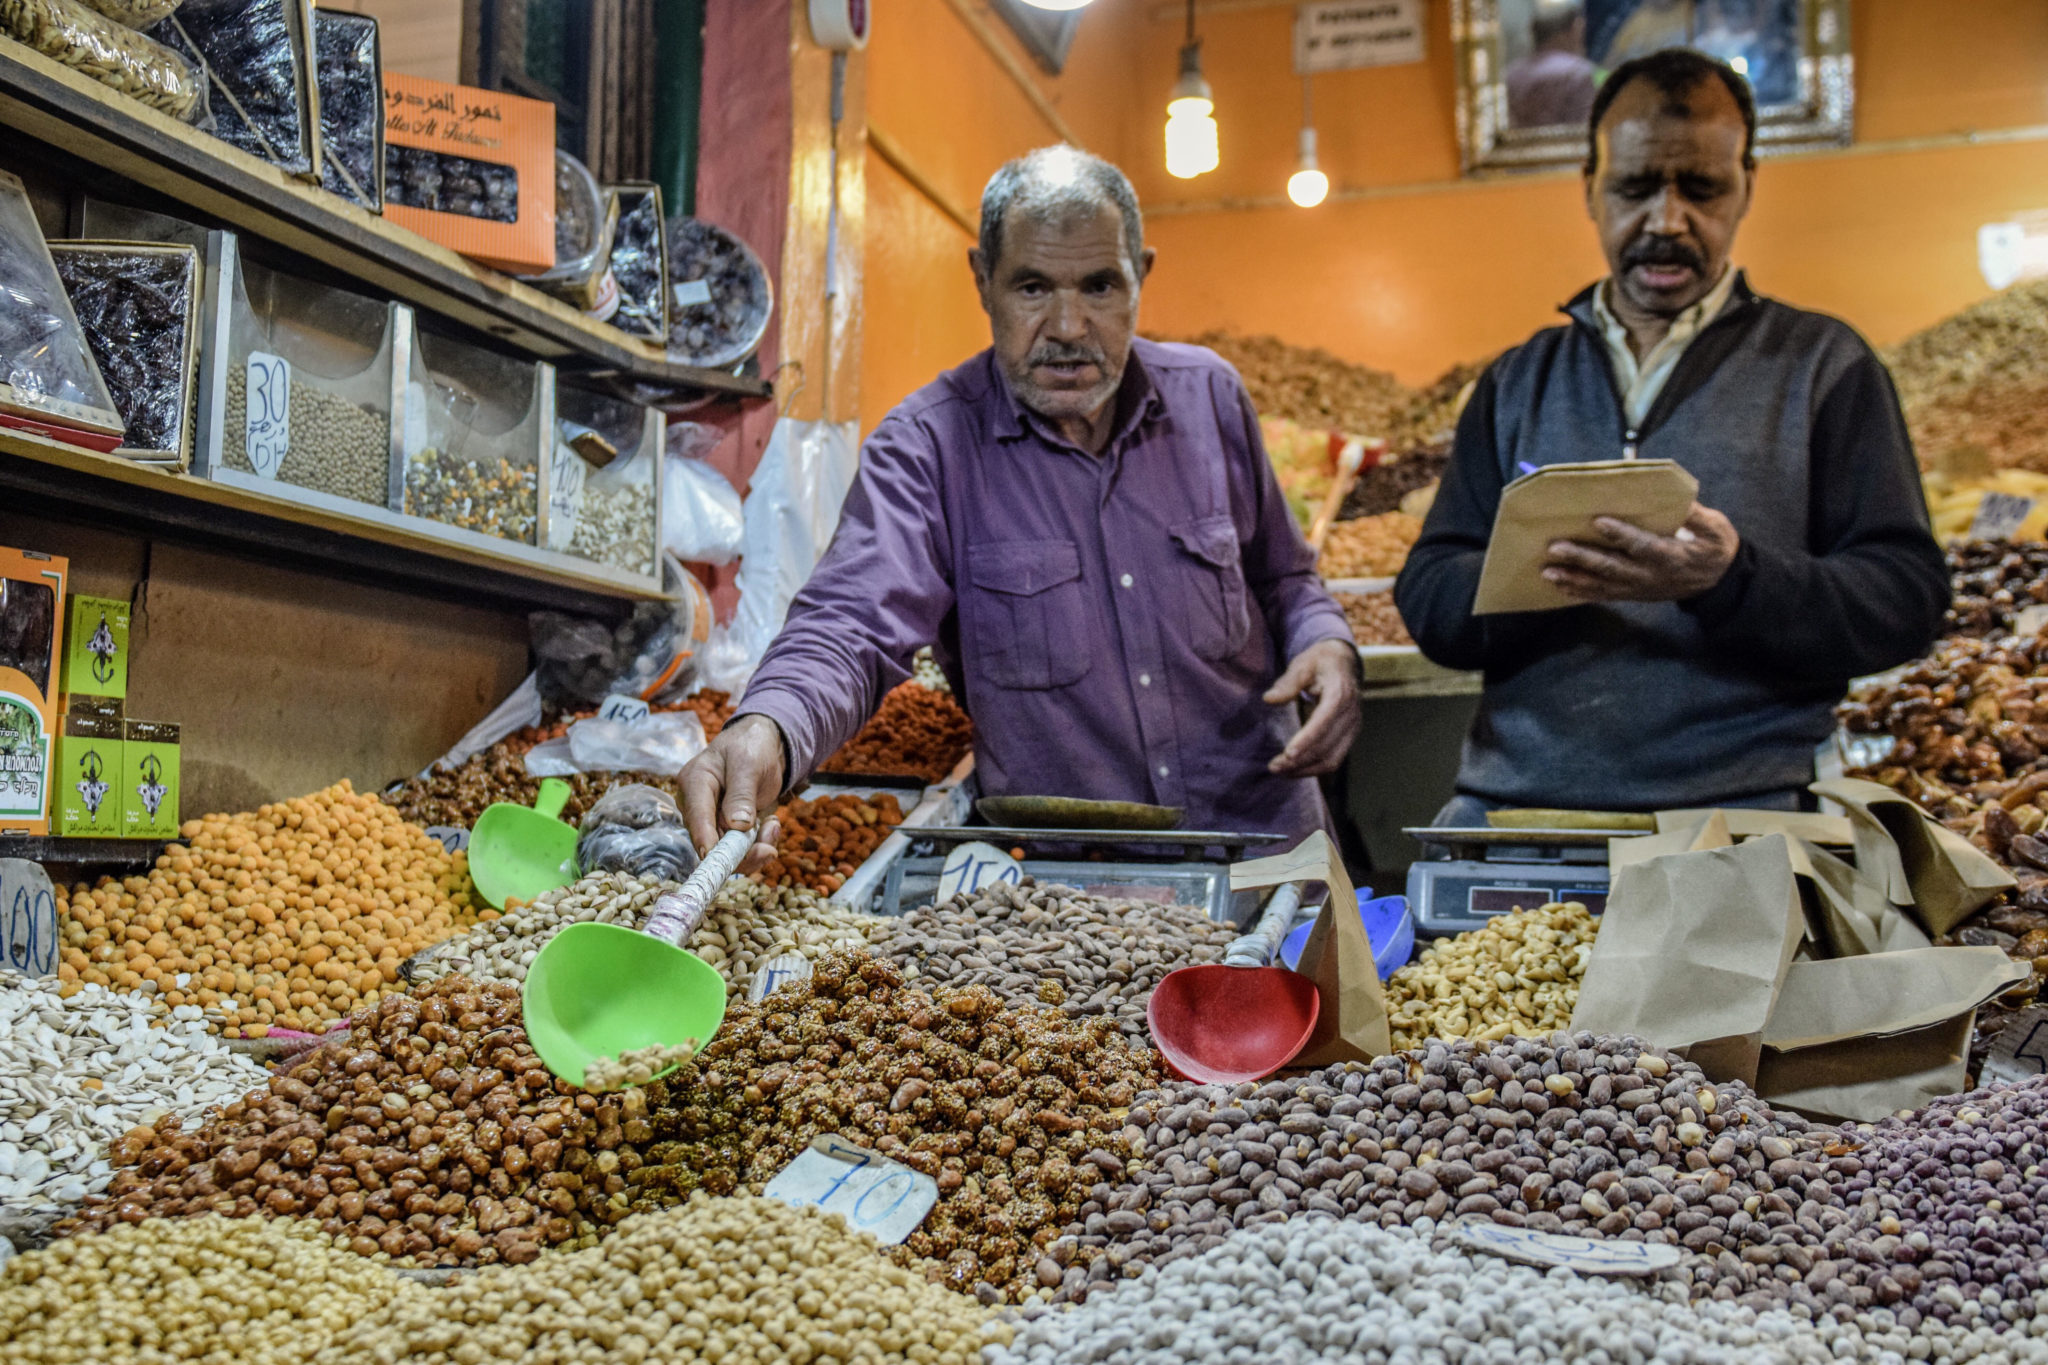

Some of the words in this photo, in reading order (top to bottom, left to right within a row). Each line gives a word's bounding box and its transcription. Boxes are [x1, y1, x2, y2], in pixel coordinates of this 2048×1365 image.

[251, 360, 287, 424] 30
[0, 874, 55, 975] 00
[829, 1142, 915, 1226] 70
